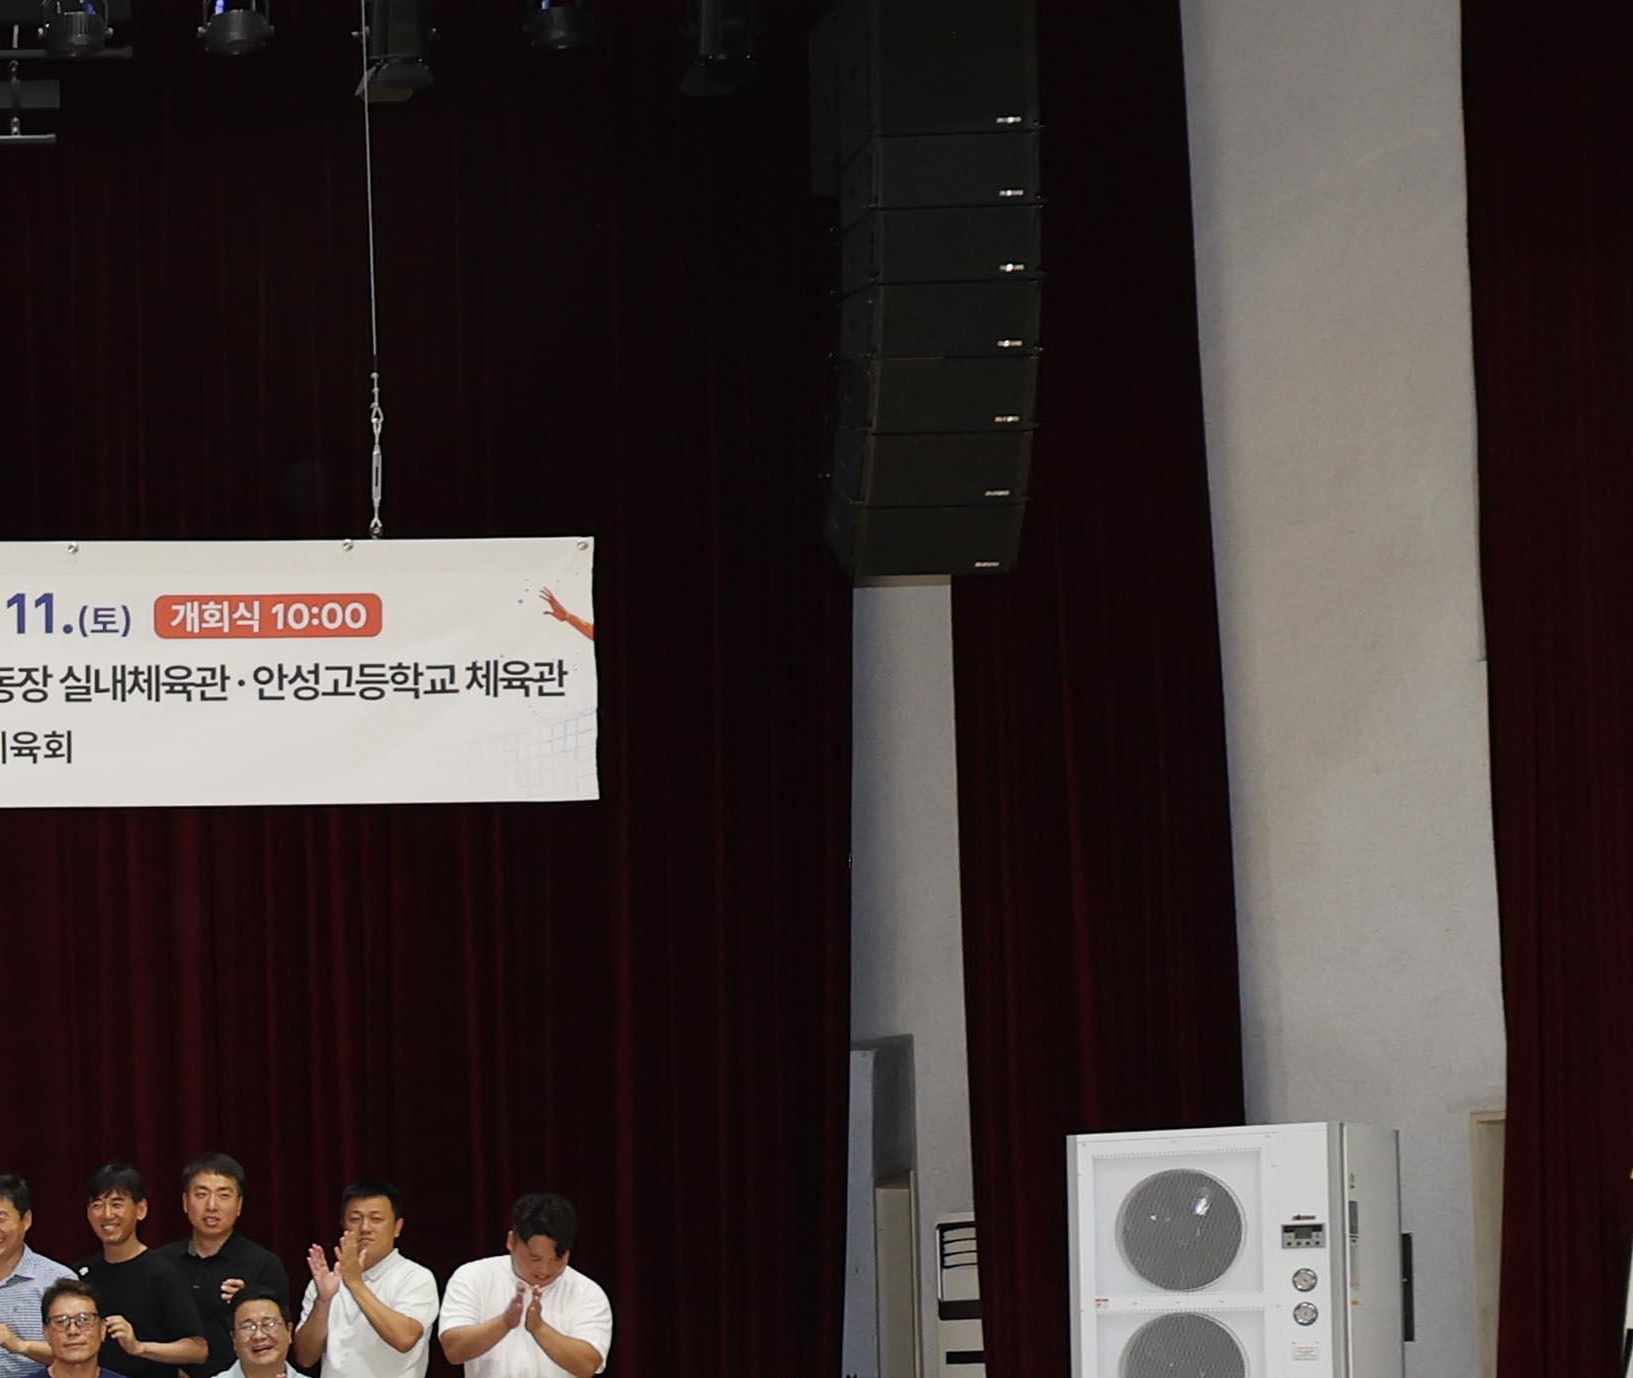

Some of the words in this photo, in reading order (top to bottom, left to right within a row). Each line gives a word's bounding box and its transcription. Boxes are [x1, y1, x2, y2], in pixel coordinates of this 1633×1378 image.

[170, 600, 262, 634] 개회식
[270, 601, 368, 631] 10:00
[465, 658, 570, 699] 체육관
